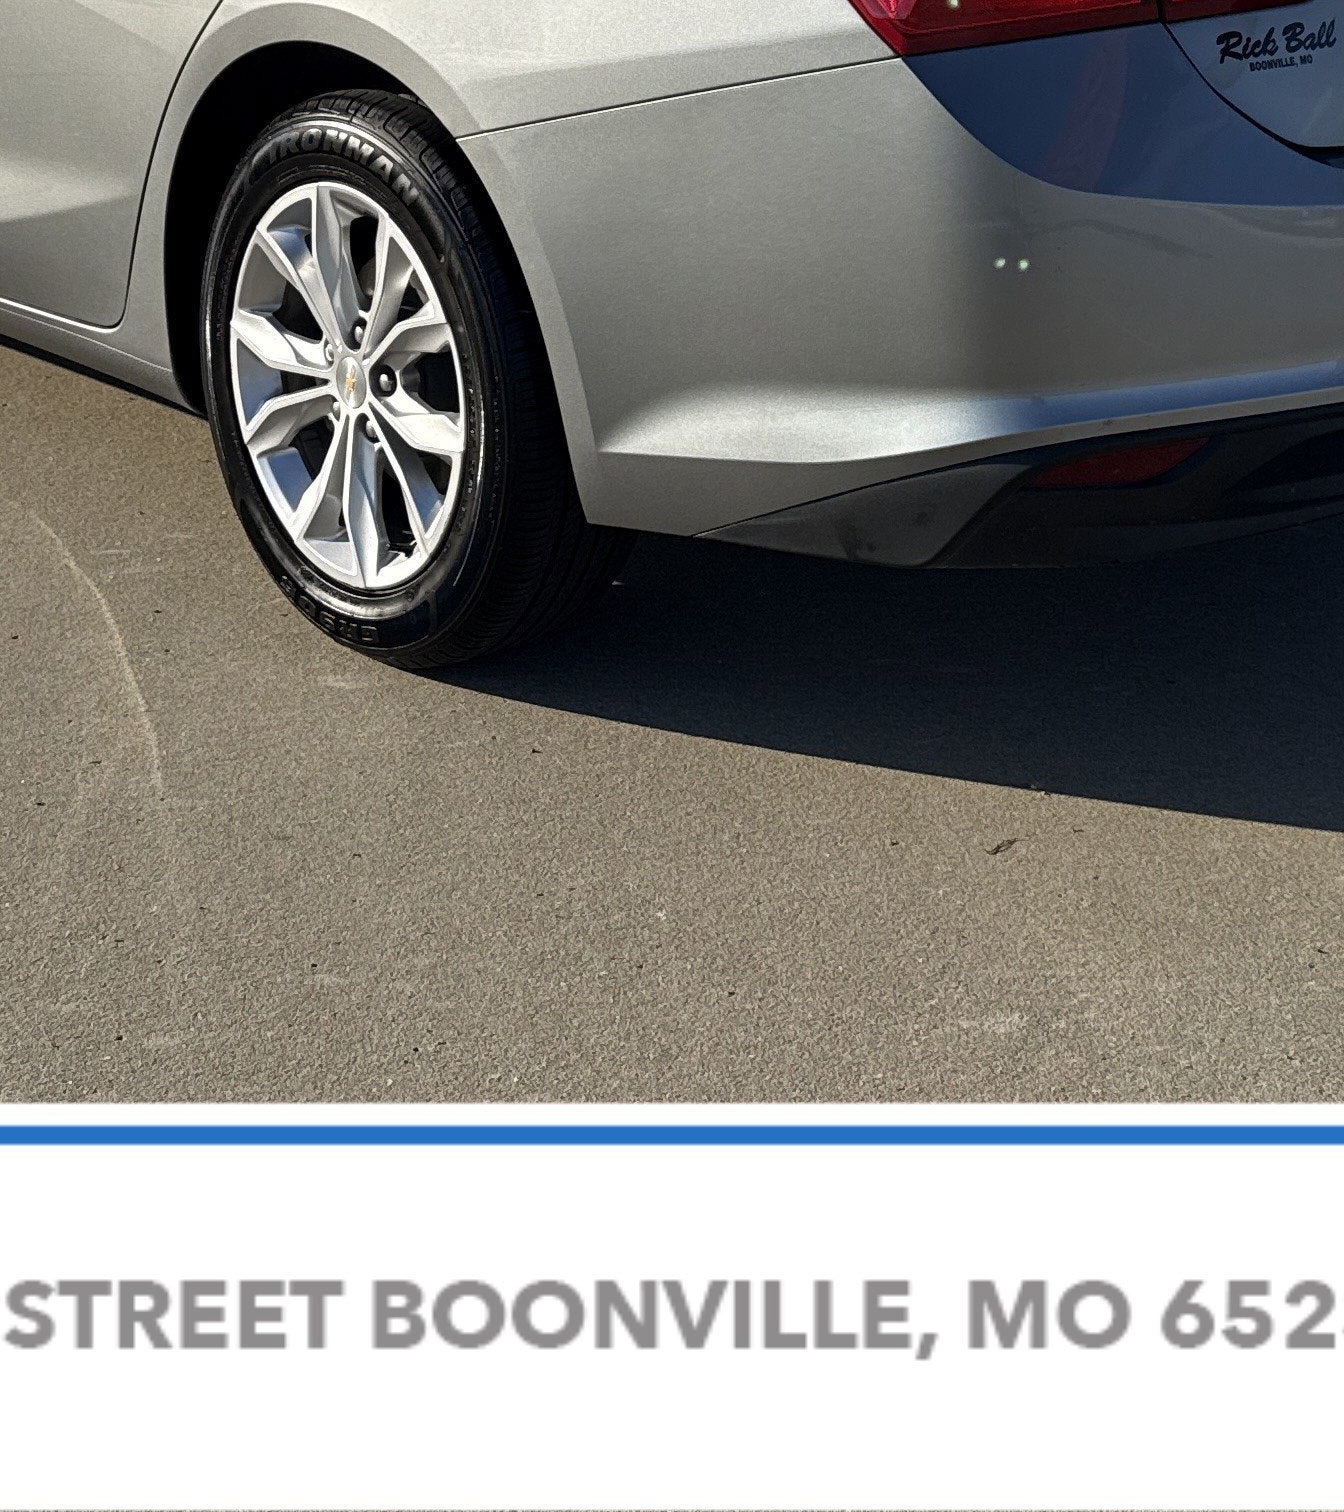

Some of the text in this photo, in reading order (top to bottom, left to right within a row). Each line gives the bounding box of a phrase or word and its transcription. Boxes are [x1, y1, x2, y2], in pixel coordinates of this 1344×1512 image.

[1216, 17, 1337, 65] Rick Ball
[1299, 54, 1313, 66] MO
[267, 127, 420, 206] IRONMAN
